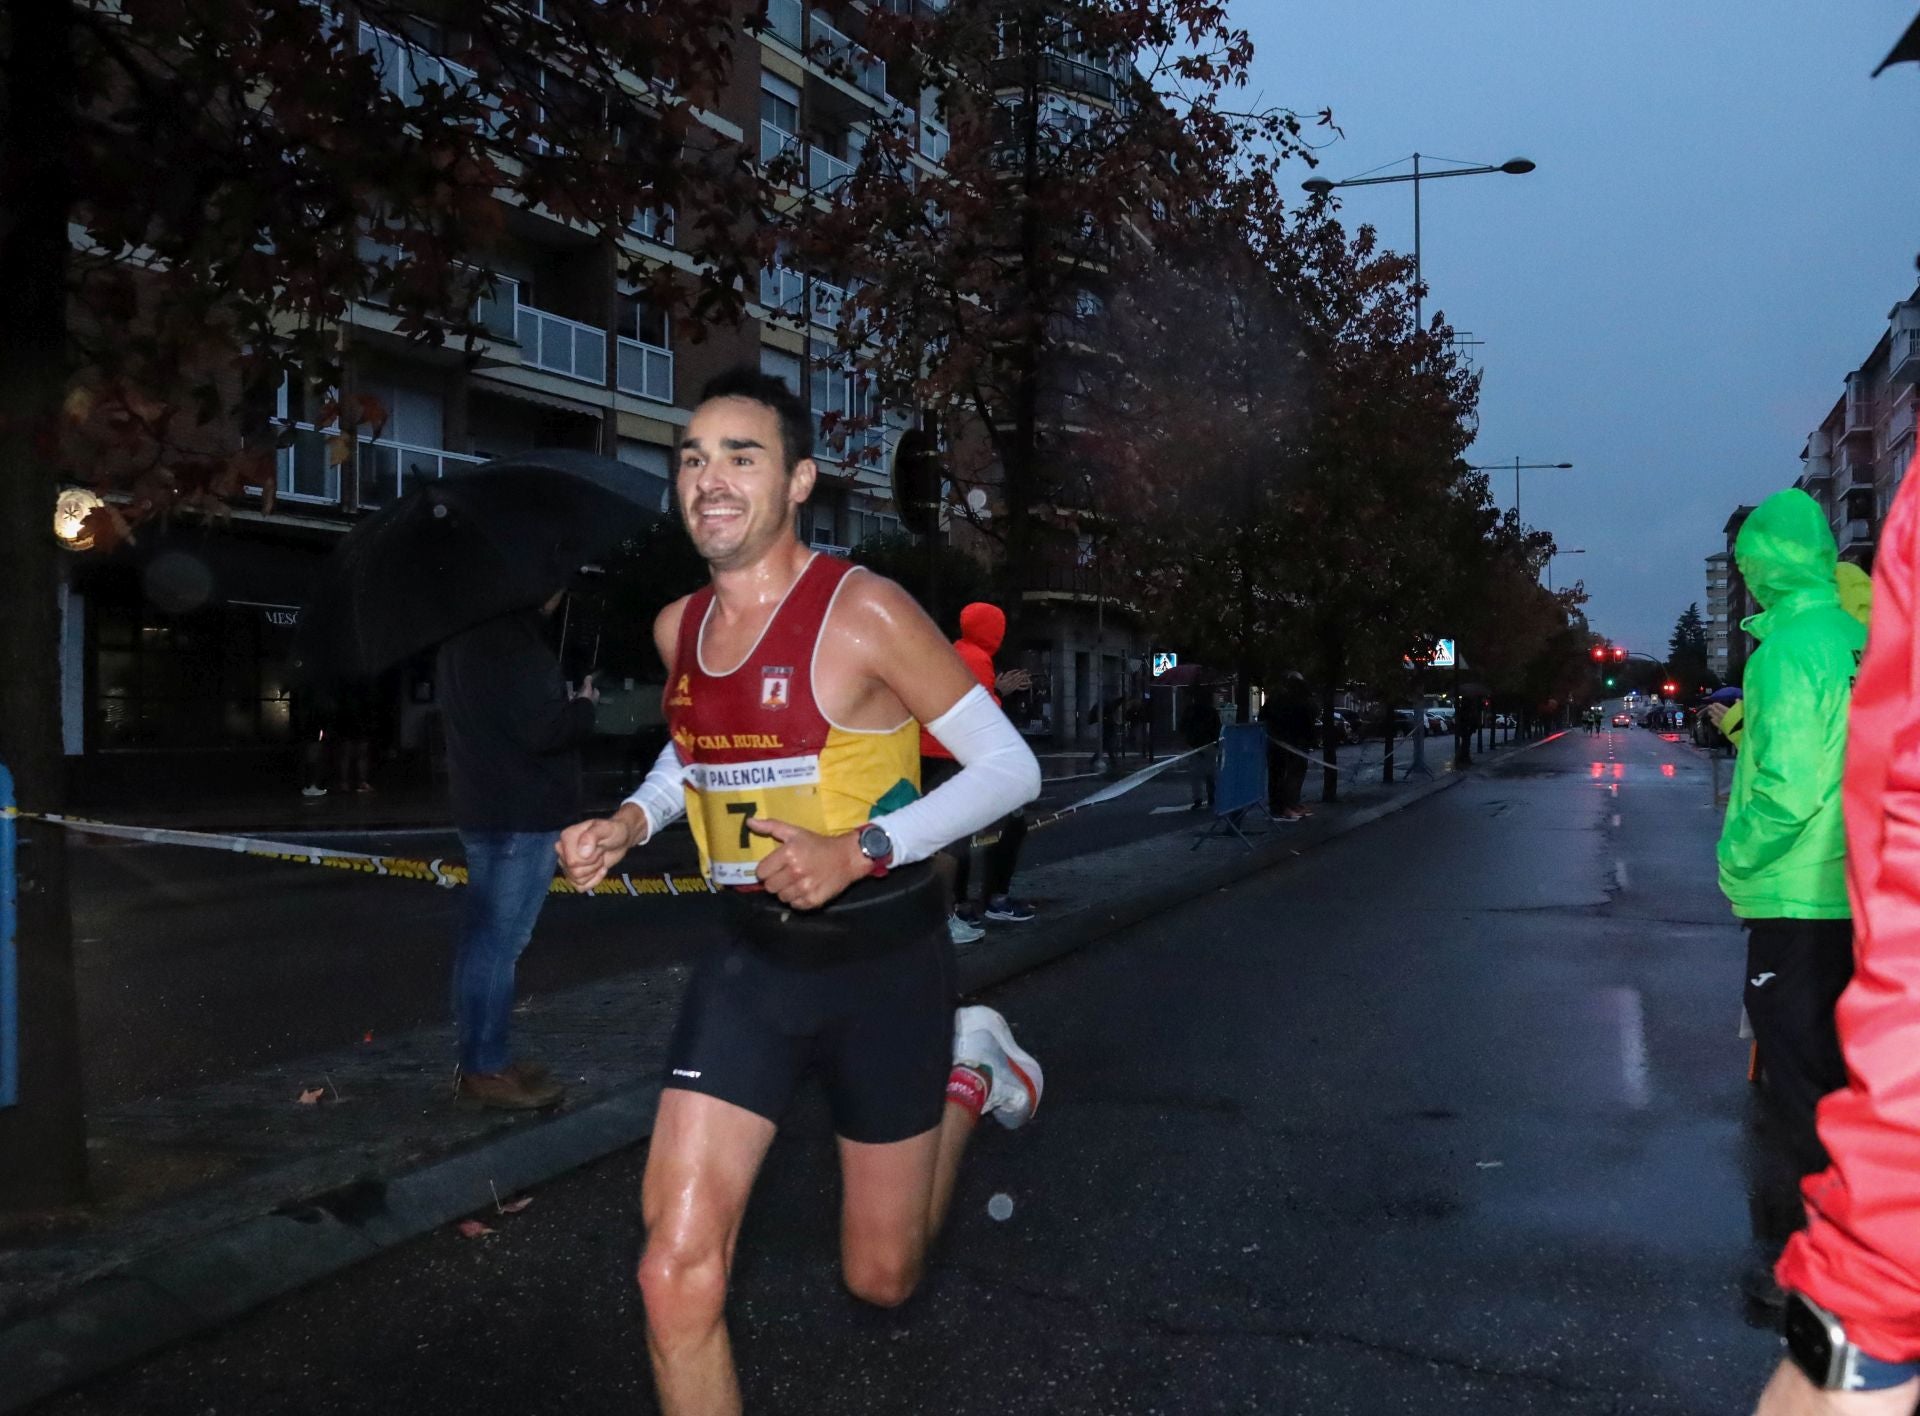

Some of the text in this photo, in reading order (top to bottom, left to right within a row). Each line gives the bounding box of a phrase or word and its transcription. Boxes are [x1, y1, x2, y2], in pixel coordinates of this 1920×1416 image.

[697, 734, 784, 749] CAJA RURAL
[709, 766, 776, 786] PALENCIA
[726, 801, 757, 849] 7
